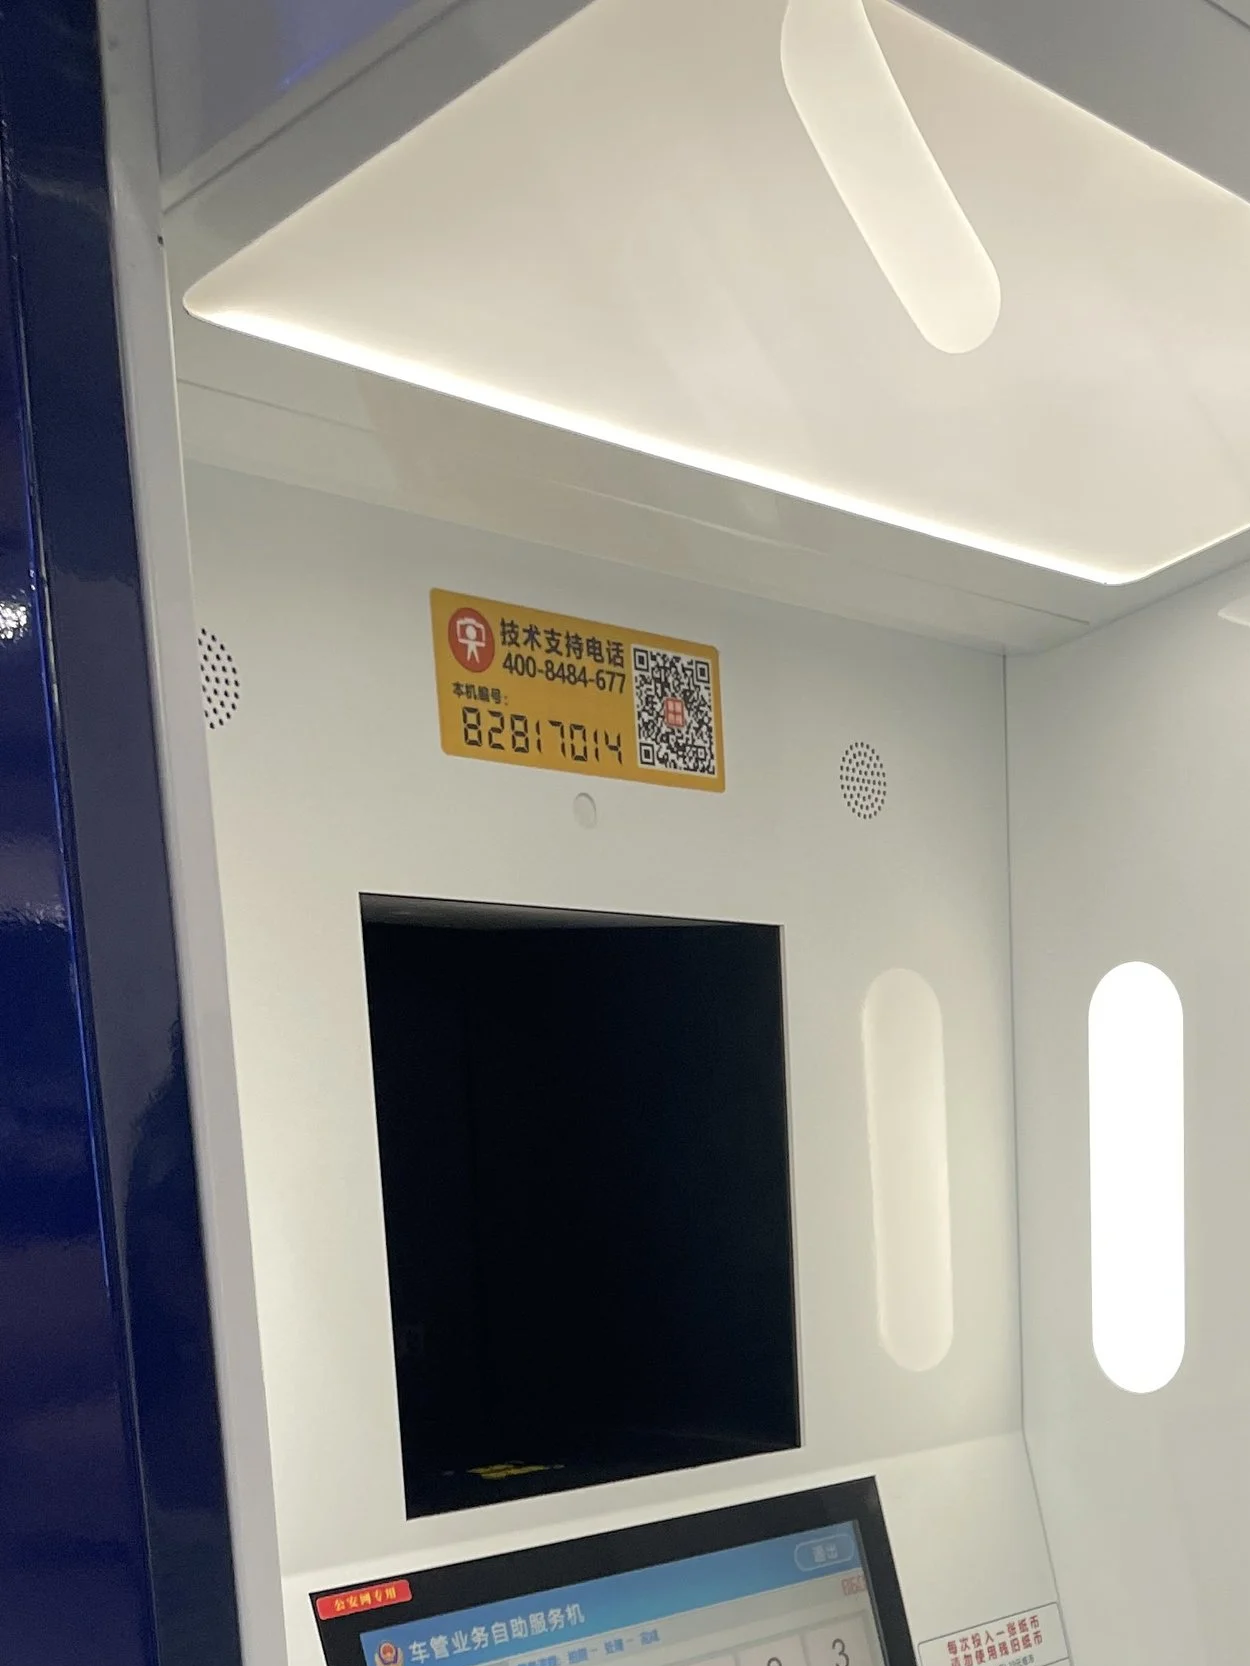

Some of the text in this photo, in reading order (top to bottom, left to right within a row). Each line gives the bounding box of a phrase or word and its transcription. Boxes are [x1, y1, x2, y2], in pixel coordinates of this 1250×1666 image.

[500, 617, 625, 669] 技术支持电话
[502, 652, 627, 695] 400-8484-677
[462, 705, 623, 765] 82817014
[334, 1586, 397, 1612] 公安网专用
[408, 1602, 586, 1665] 车管业务自助服务机
[946, 1614, 1040, 1656] 每次投入一张纸币
